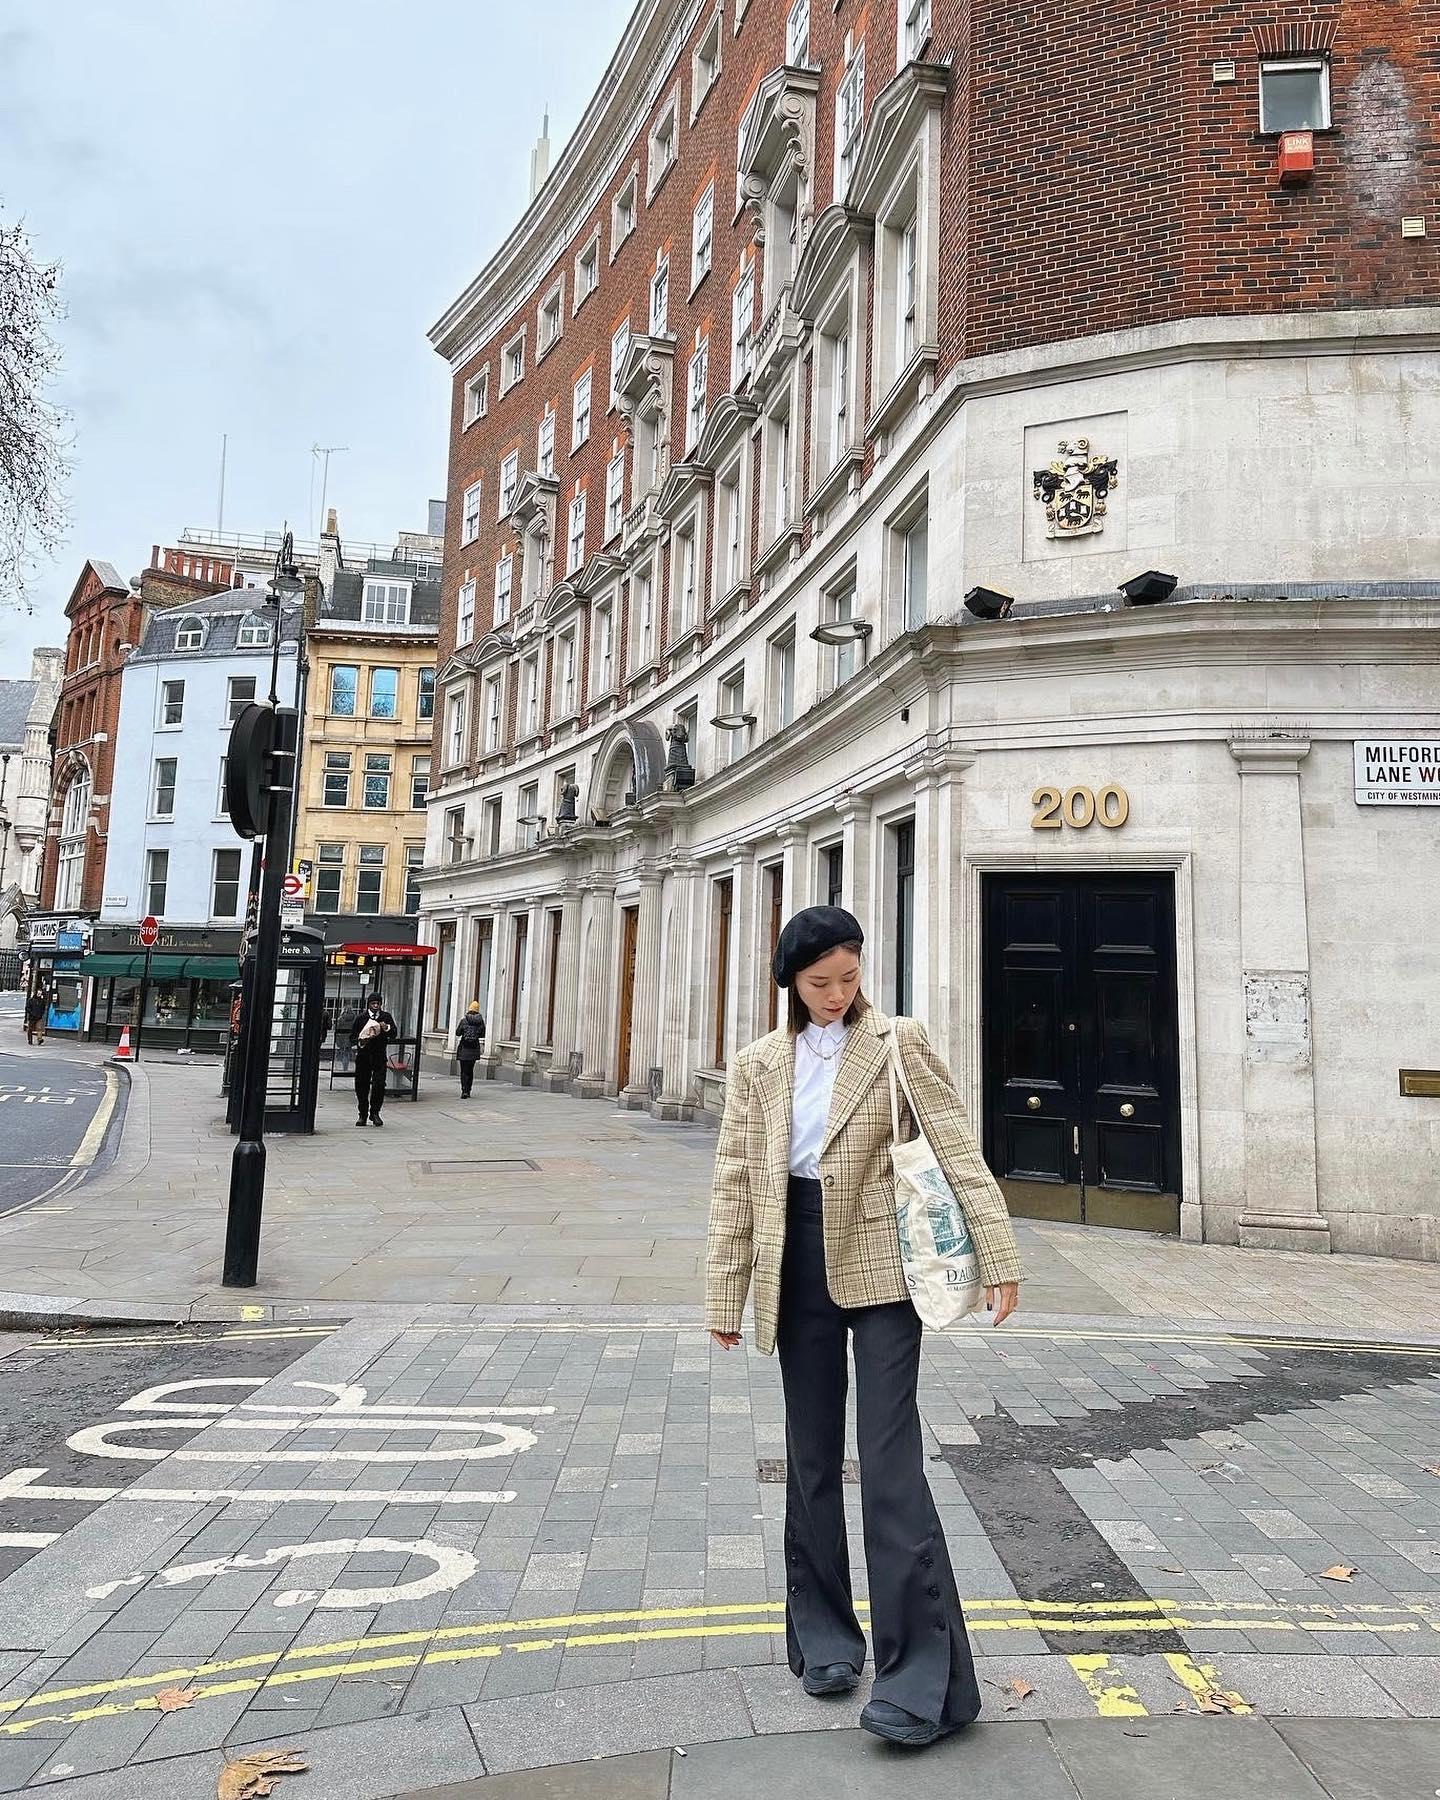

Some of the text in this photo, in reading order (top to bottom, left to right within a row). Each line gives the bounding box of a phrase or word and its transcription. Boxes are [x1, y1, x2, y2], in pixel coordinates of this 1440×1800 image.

[1366, 746, 1440, 763] MILFORD
[1366, 766, 1412, 783] LANE
[1367, 791, 1385, 800] CITY
[1387, 791, 1399, 800] OF
[1030, 784, 1130, 829] 200
[141, 926, 157, 936] STOP
[282, 946, 300, 954] here
